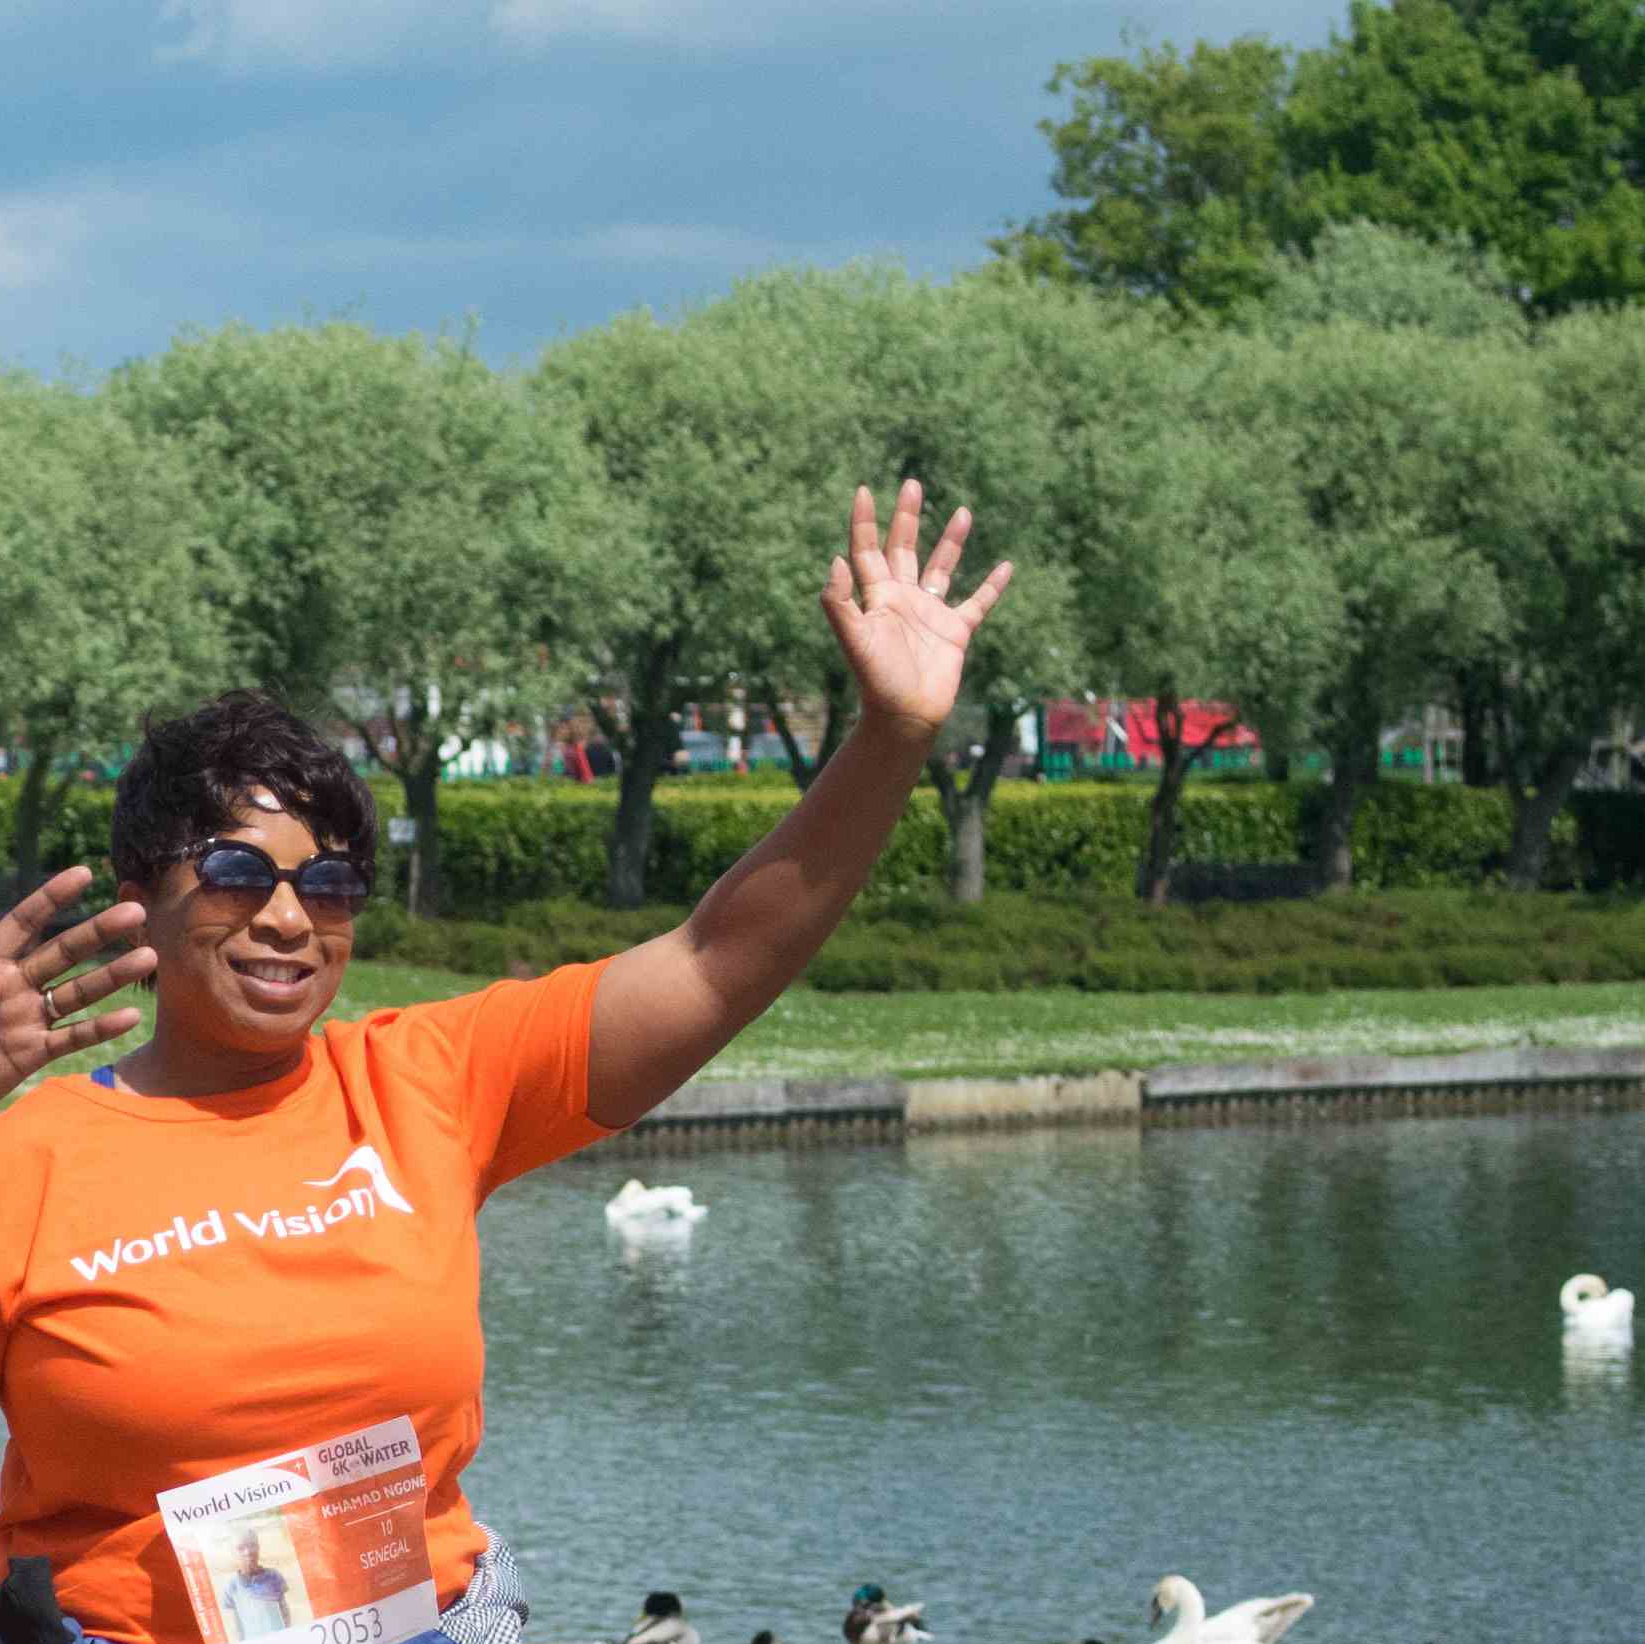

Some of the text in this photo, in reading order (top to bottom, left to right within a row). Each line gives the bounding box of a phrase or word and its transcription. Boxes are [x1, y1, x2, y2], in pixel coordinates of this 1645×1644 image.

[70, 1186, 375, 1281] World Vision
[319, 1436, 372, 1463] GLOBAL
[332, 1440, 411, 1476] 6K WATER
[172, 1478, 292, 1524] World Vision
[322, 1474, 427, 1518] KHAMAD NGONE
[381, 1519, 393, 1536] 10
[360, 1538, 411, 1569] SENEGAL
